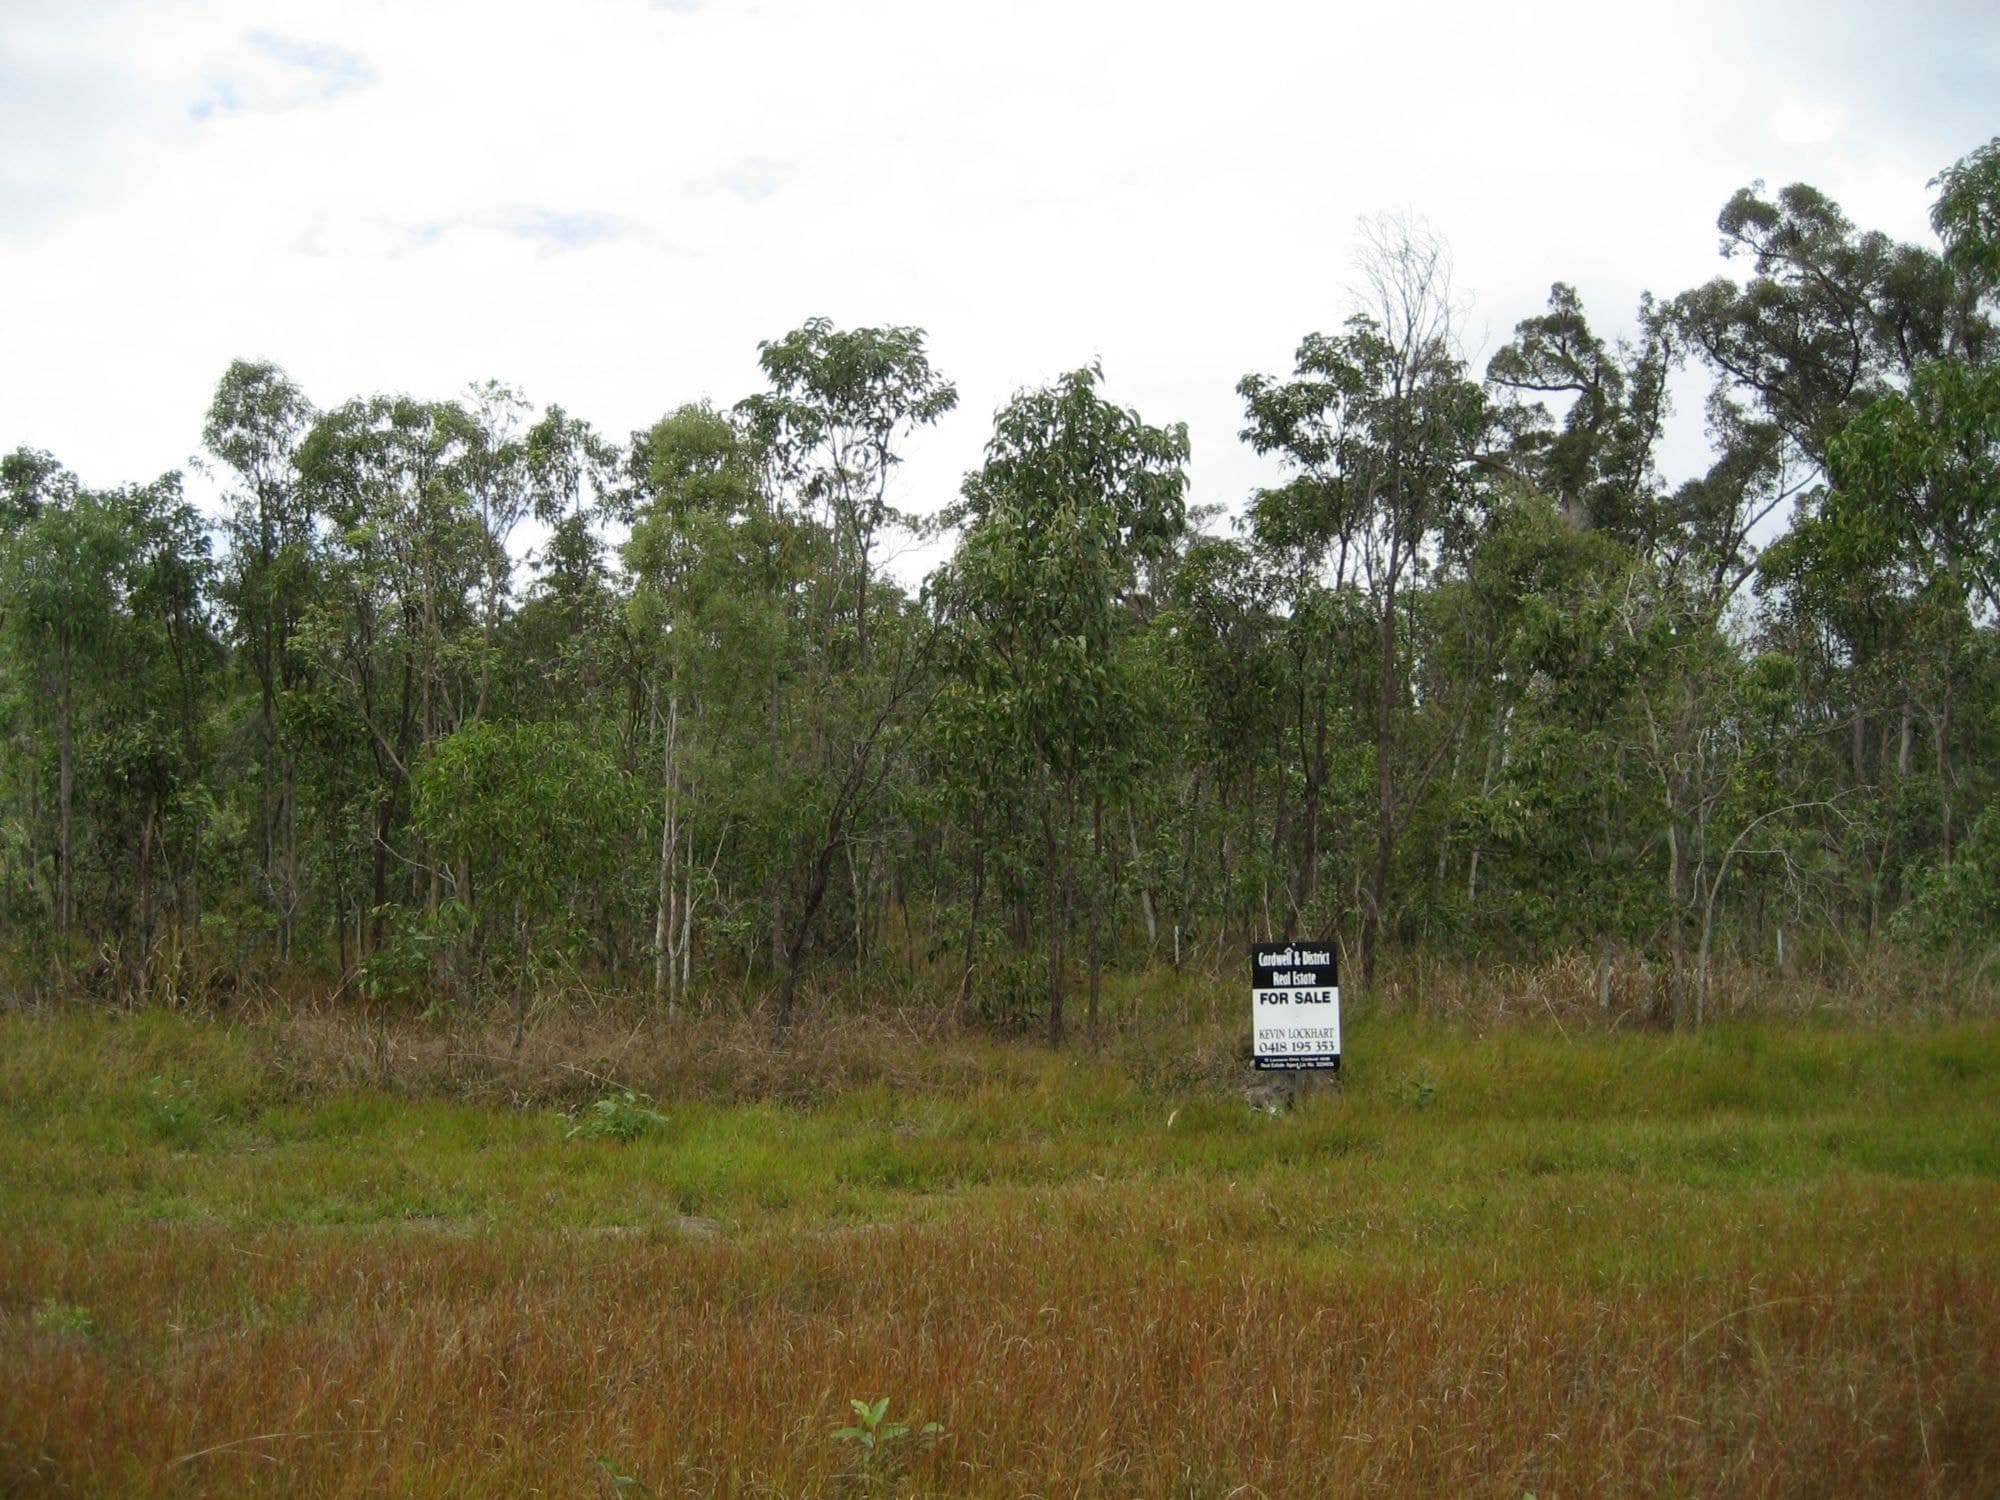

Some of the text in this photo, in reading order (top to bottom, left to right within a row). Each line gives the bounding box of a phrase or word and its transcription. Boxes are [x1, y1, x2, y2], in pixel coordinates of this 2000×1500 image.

[1258, 950, 1330, 967] Cardwell & District
[1272, 970, 1316, 986] Real Estate
[1260, 991, 1331, 1005] FOR SALE
[1259, 1028, 1334, 1040] KEVIN LOCKHART
[1259, 1040, 1334, 1053] 0418 195 353
